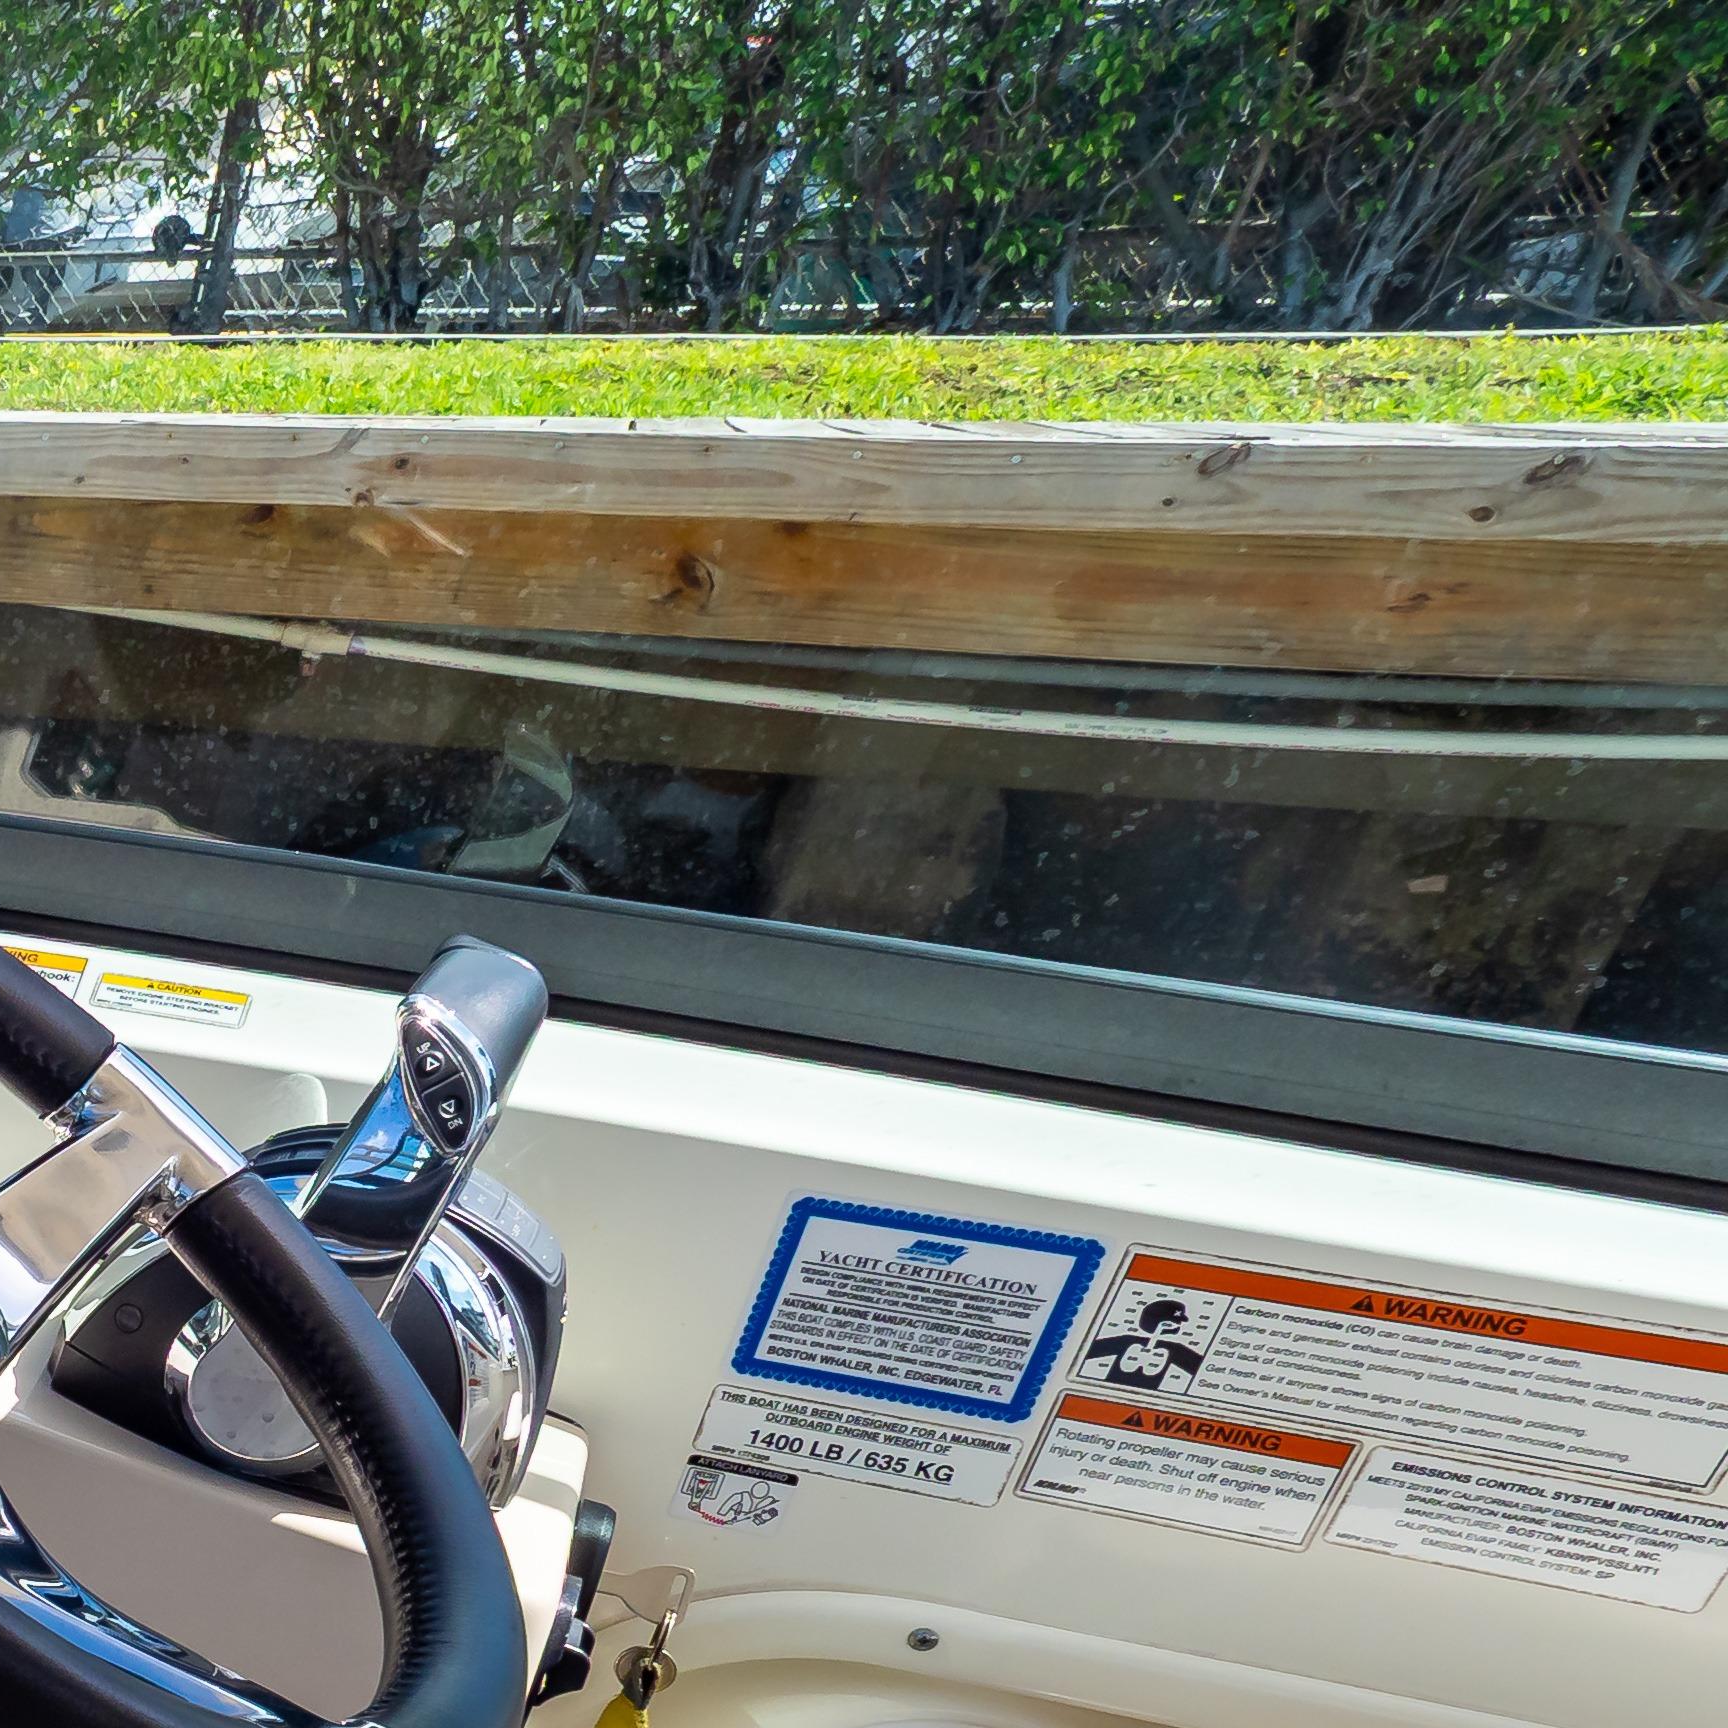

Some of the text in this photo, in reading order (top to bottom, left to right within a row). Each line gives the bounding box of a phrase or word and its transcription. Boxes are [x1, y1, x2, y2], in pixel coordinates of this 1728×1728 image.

[157, 984, 201, 995] CAUTION
[416, 1042, 431, 1054] UP
[447, 1117, 464, 1130] DN
[820, 1250, 882, 1270] YACHT
[885, 1262, 1037, 1295] CERTIFICATION
[777, 1309, 1027, 1359] THIS BOAT COMPLIES WITH U.S. COAST GUARD SAFETY
[782, 1298, 1031, 1347] NATIONAL MARINE MANUFACTURERS ASSOCIATION
[1384, 1298, 1528, 1336] WARNING
[769, 1320, 1024, 1372] STANDARDS IN EFFECT ON THE DATE OF CERTIFICATION
[767, 1346, 1002, 1396] BOSTON WHALER, INC. EDGEWATER, FL
[720, 1391, 1011, 1452] THIS BOAT HAS BEEN DESIGNED FOR A MAXIMUM
[765, 1413, 952, 1454] OUTBOARD ENGINE WEIGHT OF
[1154, 1414, 1282, 1451] WARNING
[697, 1457, 741, 1474] ATTACH
[744, 1430, 804, 1454] 1400
[809, 1441, 844, 1460] LB
[864, 1452, 909, 1473] 635
[914, 1461, 954, 1482] KG
[1049, 1444, 1316, 1501] injury or death. Shut off engine when
[1056, 1428, 1325, 1486] Rotating propeller may cause serious
[1078, 1468, 1265, 1510] near persons in the water.
[1391, 1462, 1727, 1530] EMISSIONS CONTROL SYSTEM INFORMATION
[1506, 1526, 1564, 1542] BOSTON
[1567, 1538, 1629, 1556] WHALER,
[1634, 1550, 1661, 1561] INC.
